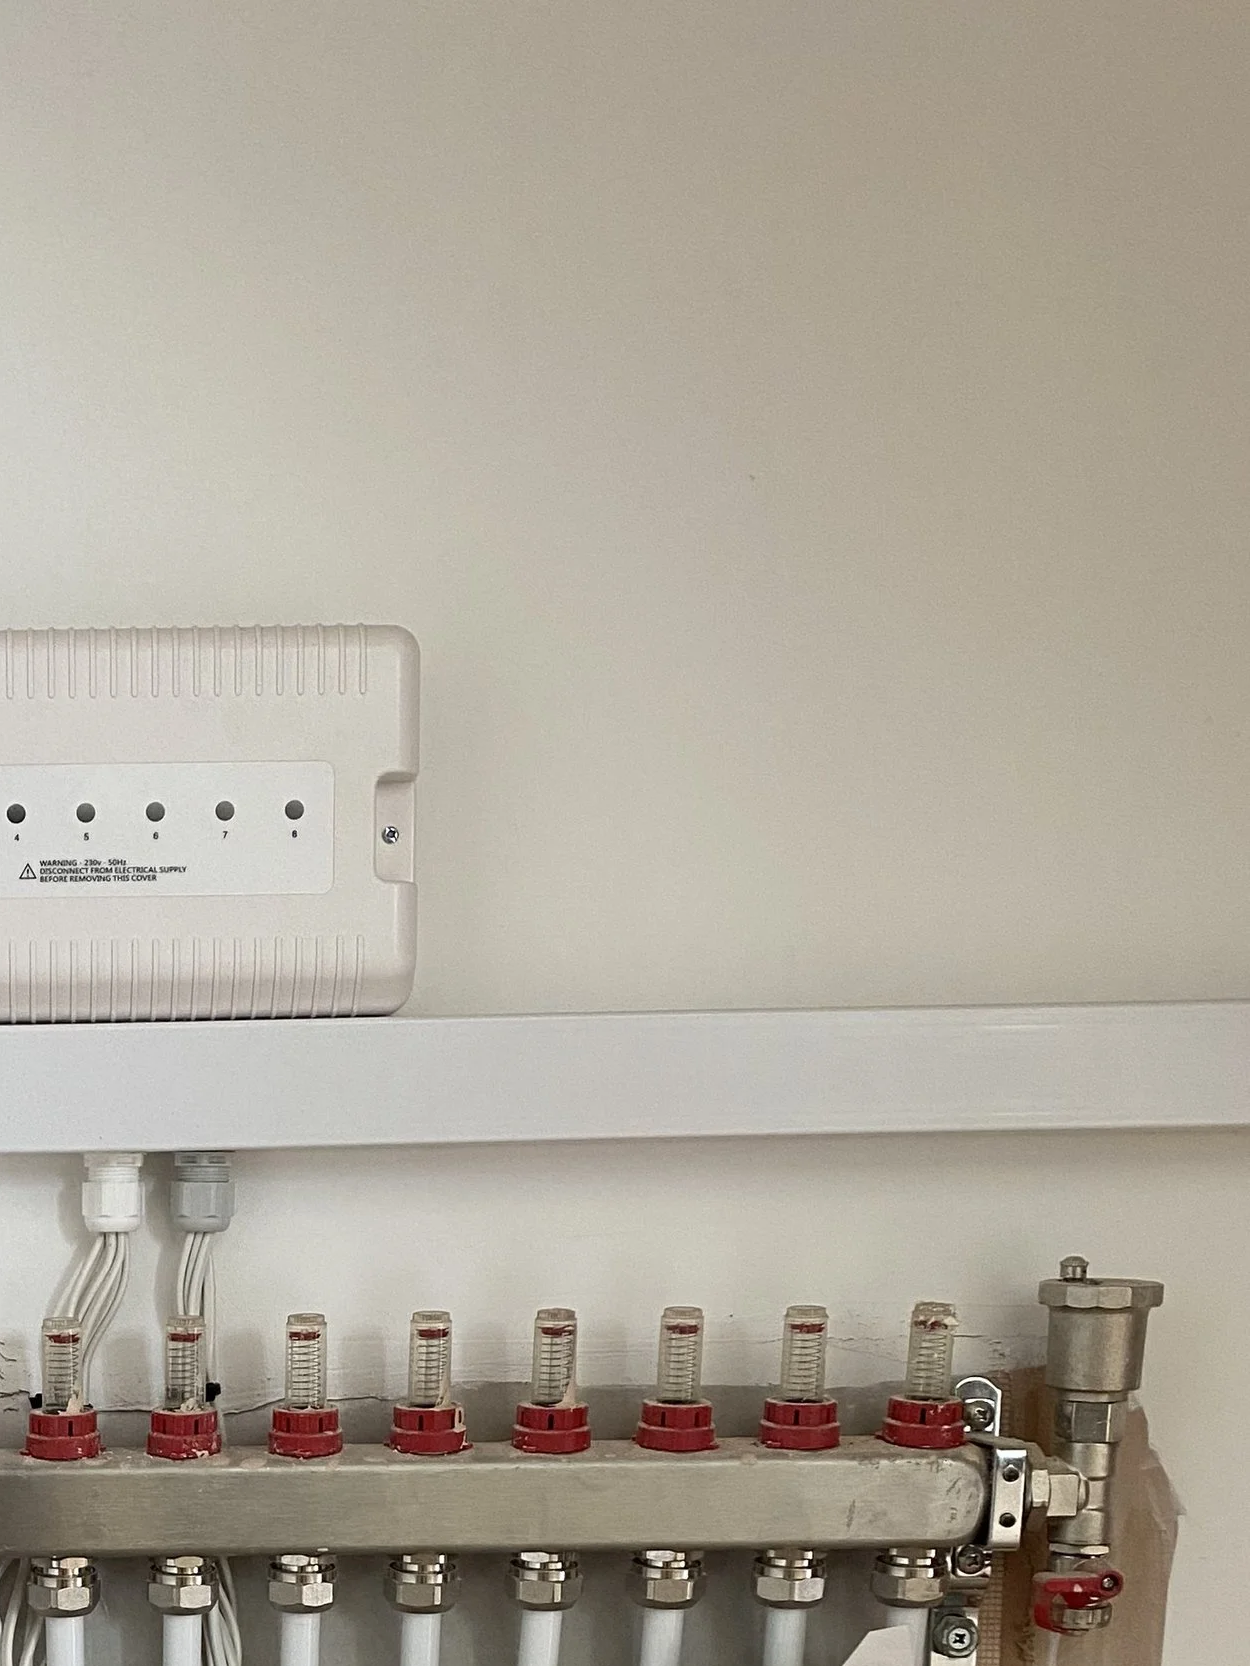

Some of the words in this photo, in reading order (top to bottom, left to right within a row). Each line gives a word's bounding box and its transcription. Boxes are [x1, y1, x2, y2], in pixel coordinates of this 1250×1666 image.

[13, 833, 21, 842] 4
[83, 832, 90, 842] 5
[152, 831, 159, 841] 6
[221, 830, 228, 840] 7
[291, 829, 298, 839] 8
[39, 859, 78, 867] WARNING
[39, 867, 90, 875] DISCONNECT
[90, 867, 113, 875] FROM
[114, 866, 158, 874] ELECTRICAL
[159, 865, 187, 874] SUPPLY
[39, 875, 68, 883] BEFORE
[69, 875, 112, 883] REMOVING
[113, 874, 130, 882] THIS
[131, 874, 158, 882] COVER
